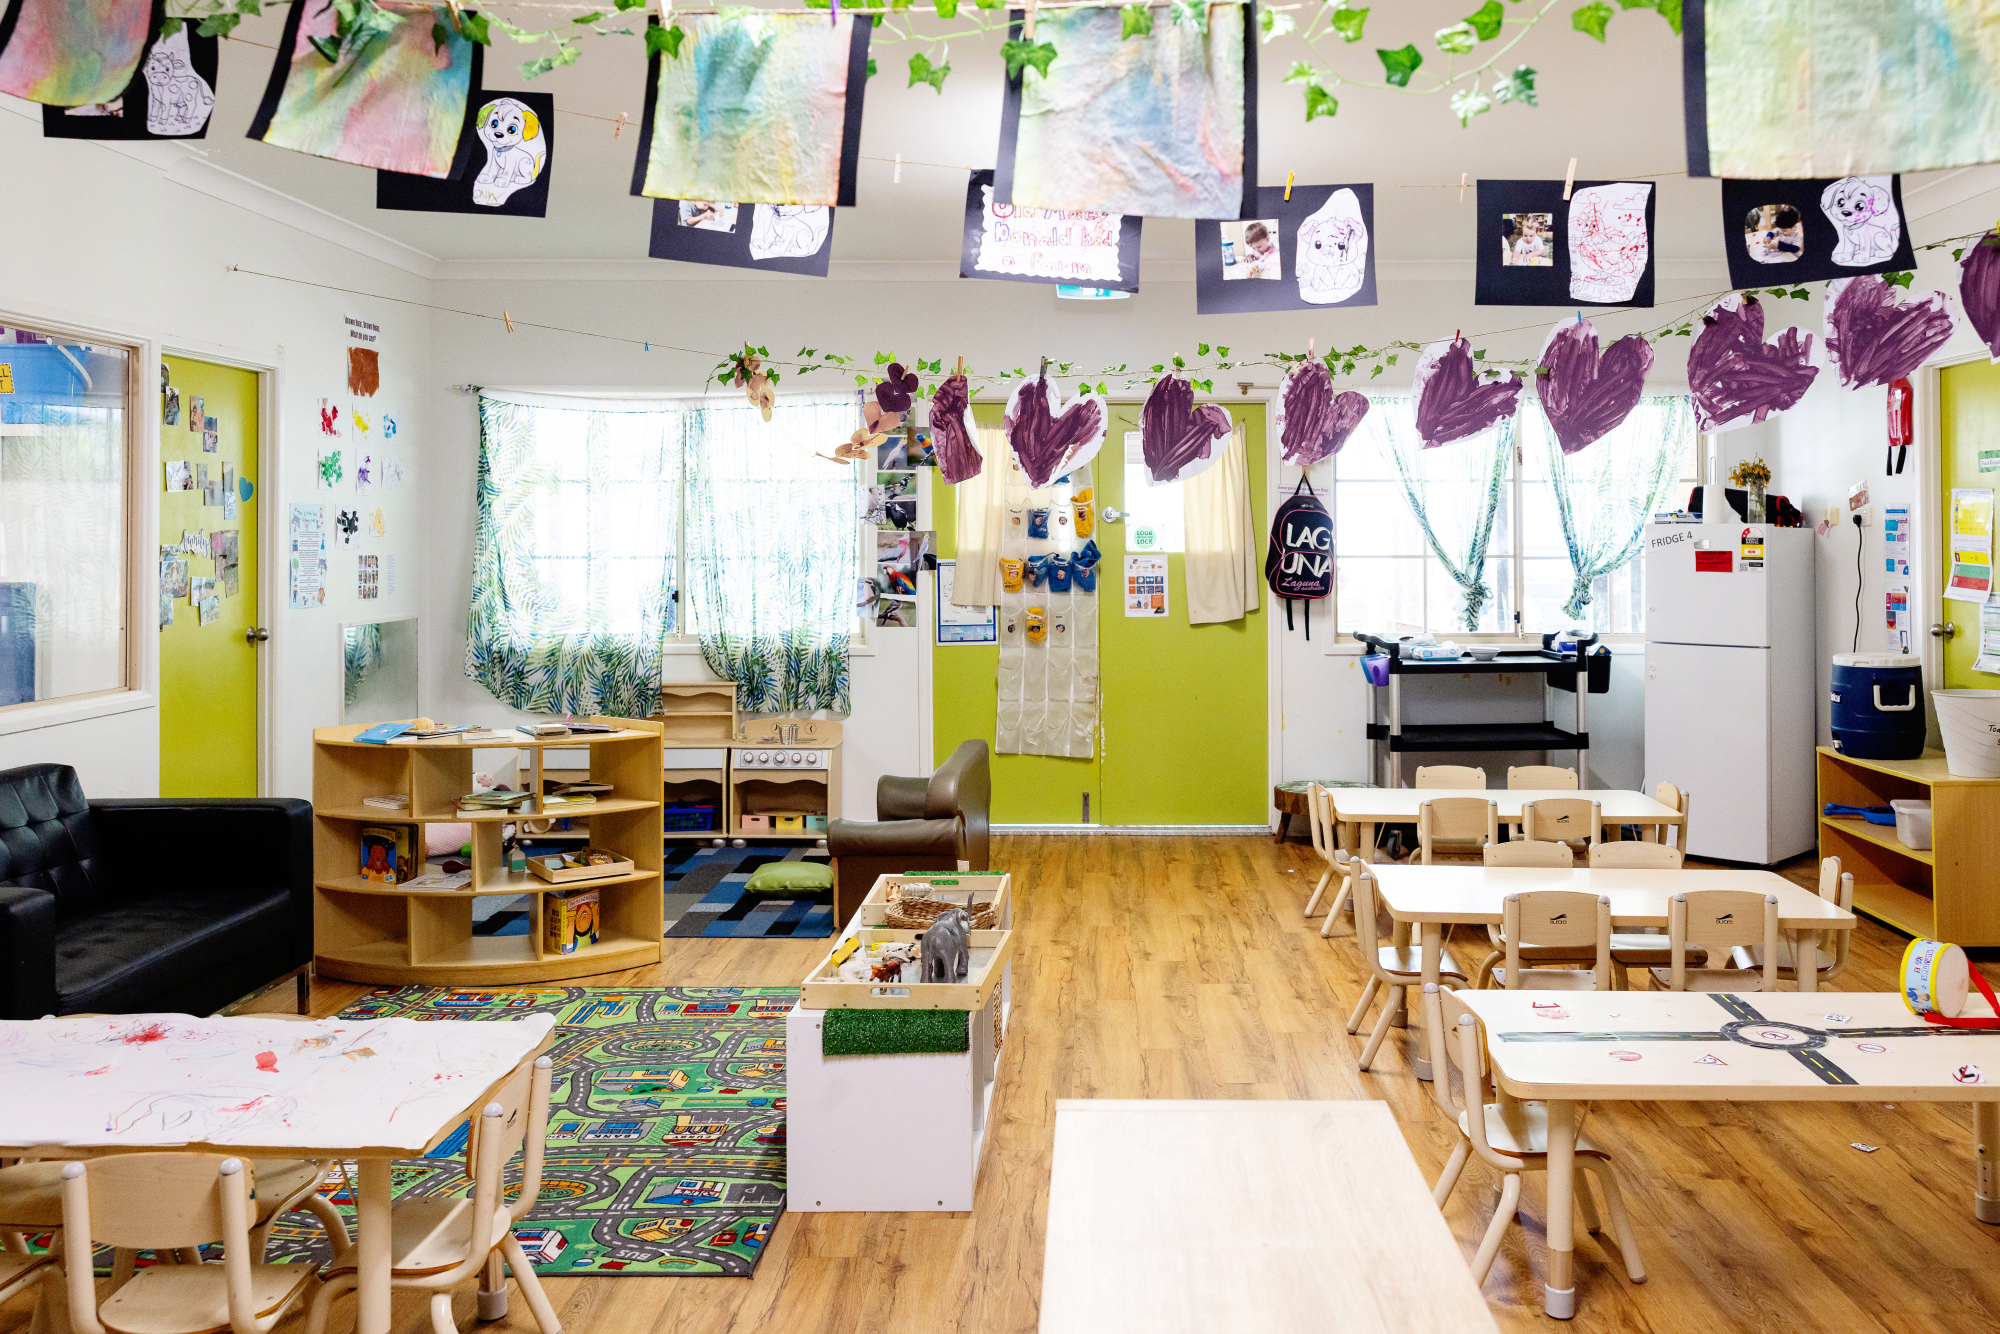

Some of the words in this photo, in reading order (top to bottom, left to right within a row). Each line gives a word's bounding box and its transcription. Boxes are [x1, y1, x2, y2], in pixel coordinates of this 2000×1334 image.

[994, 221, 1072, 247] Donald
[1080, 227, 1113, 247] had
[1030, 251, 1092, 274] farm
[180, 528, 210, 559] family
[1286, 523, 1331, 550] LAG
[1651, 532, 1685, 548] FRIDGE
[1686, 530, 1693, 540] 4
[1281, 577, 1321, 591] Laguna
[616, 1249, 651, 1260] BUS
